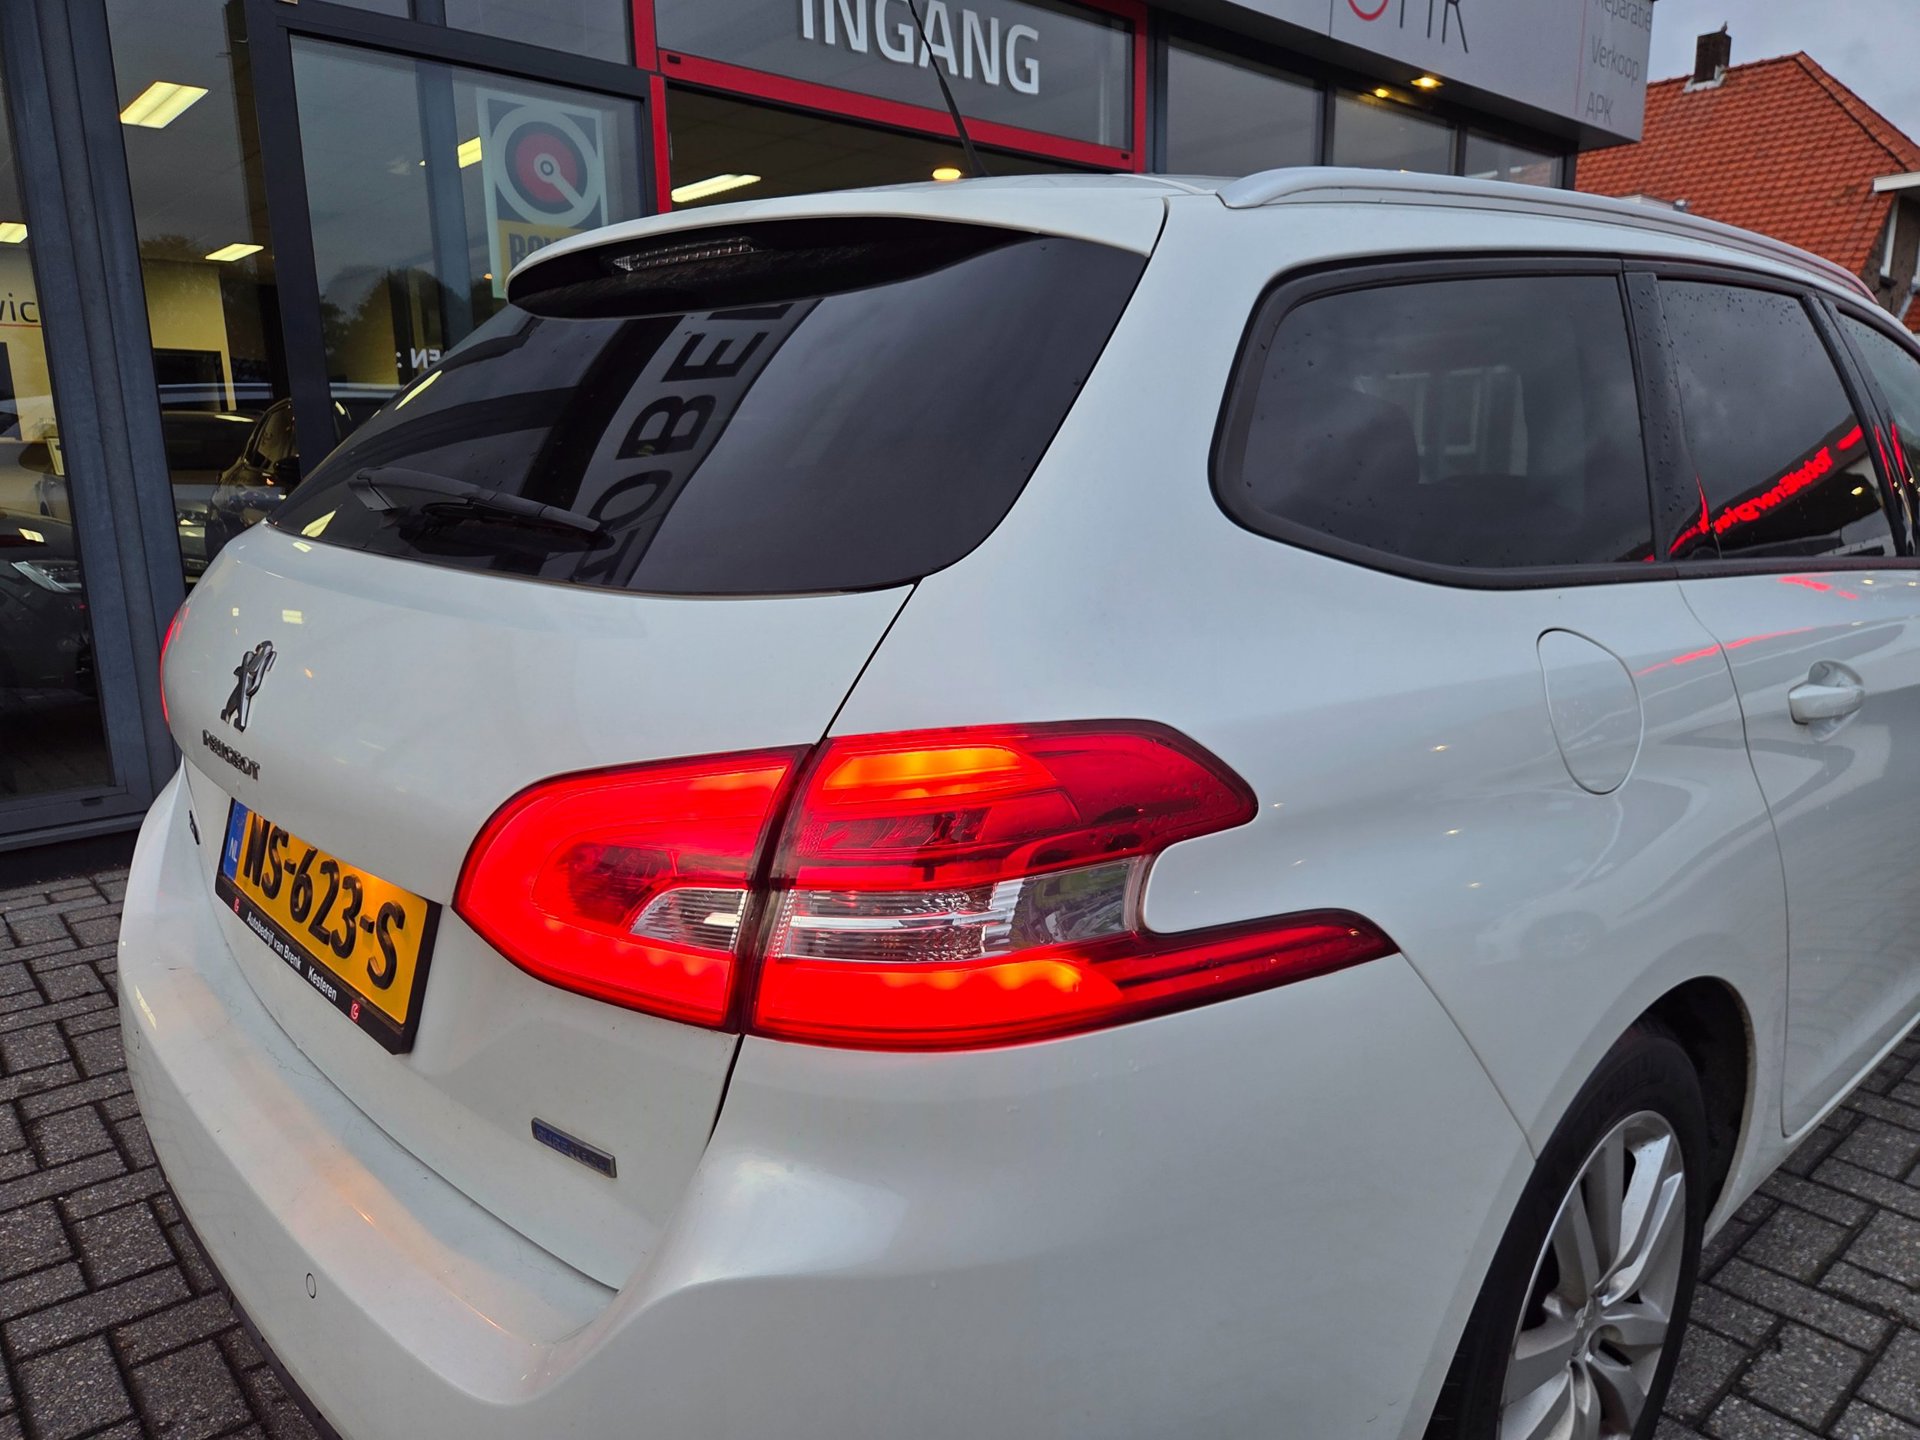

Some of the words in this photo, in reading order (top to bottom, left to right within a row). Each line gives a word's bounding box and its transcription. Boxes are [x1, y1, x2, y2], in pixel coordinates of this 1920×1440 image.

[802, 0, 1039, 95] INGANG
[1592, 34, 1639, 87] Verkoop
[1585, 91, 1614, 126] APK
[202, 729, 261, 781] PEUGEOT
[229, 836, 238, 863] NL
[243, 812, 406, 990] NS-623-S
[246, 911, 275, 948] Autobedrijf
[273, 940, 284, 955] van
[284, 944, 302, 970] Brenk
[307, 965, 338, 1001] Kesteren
